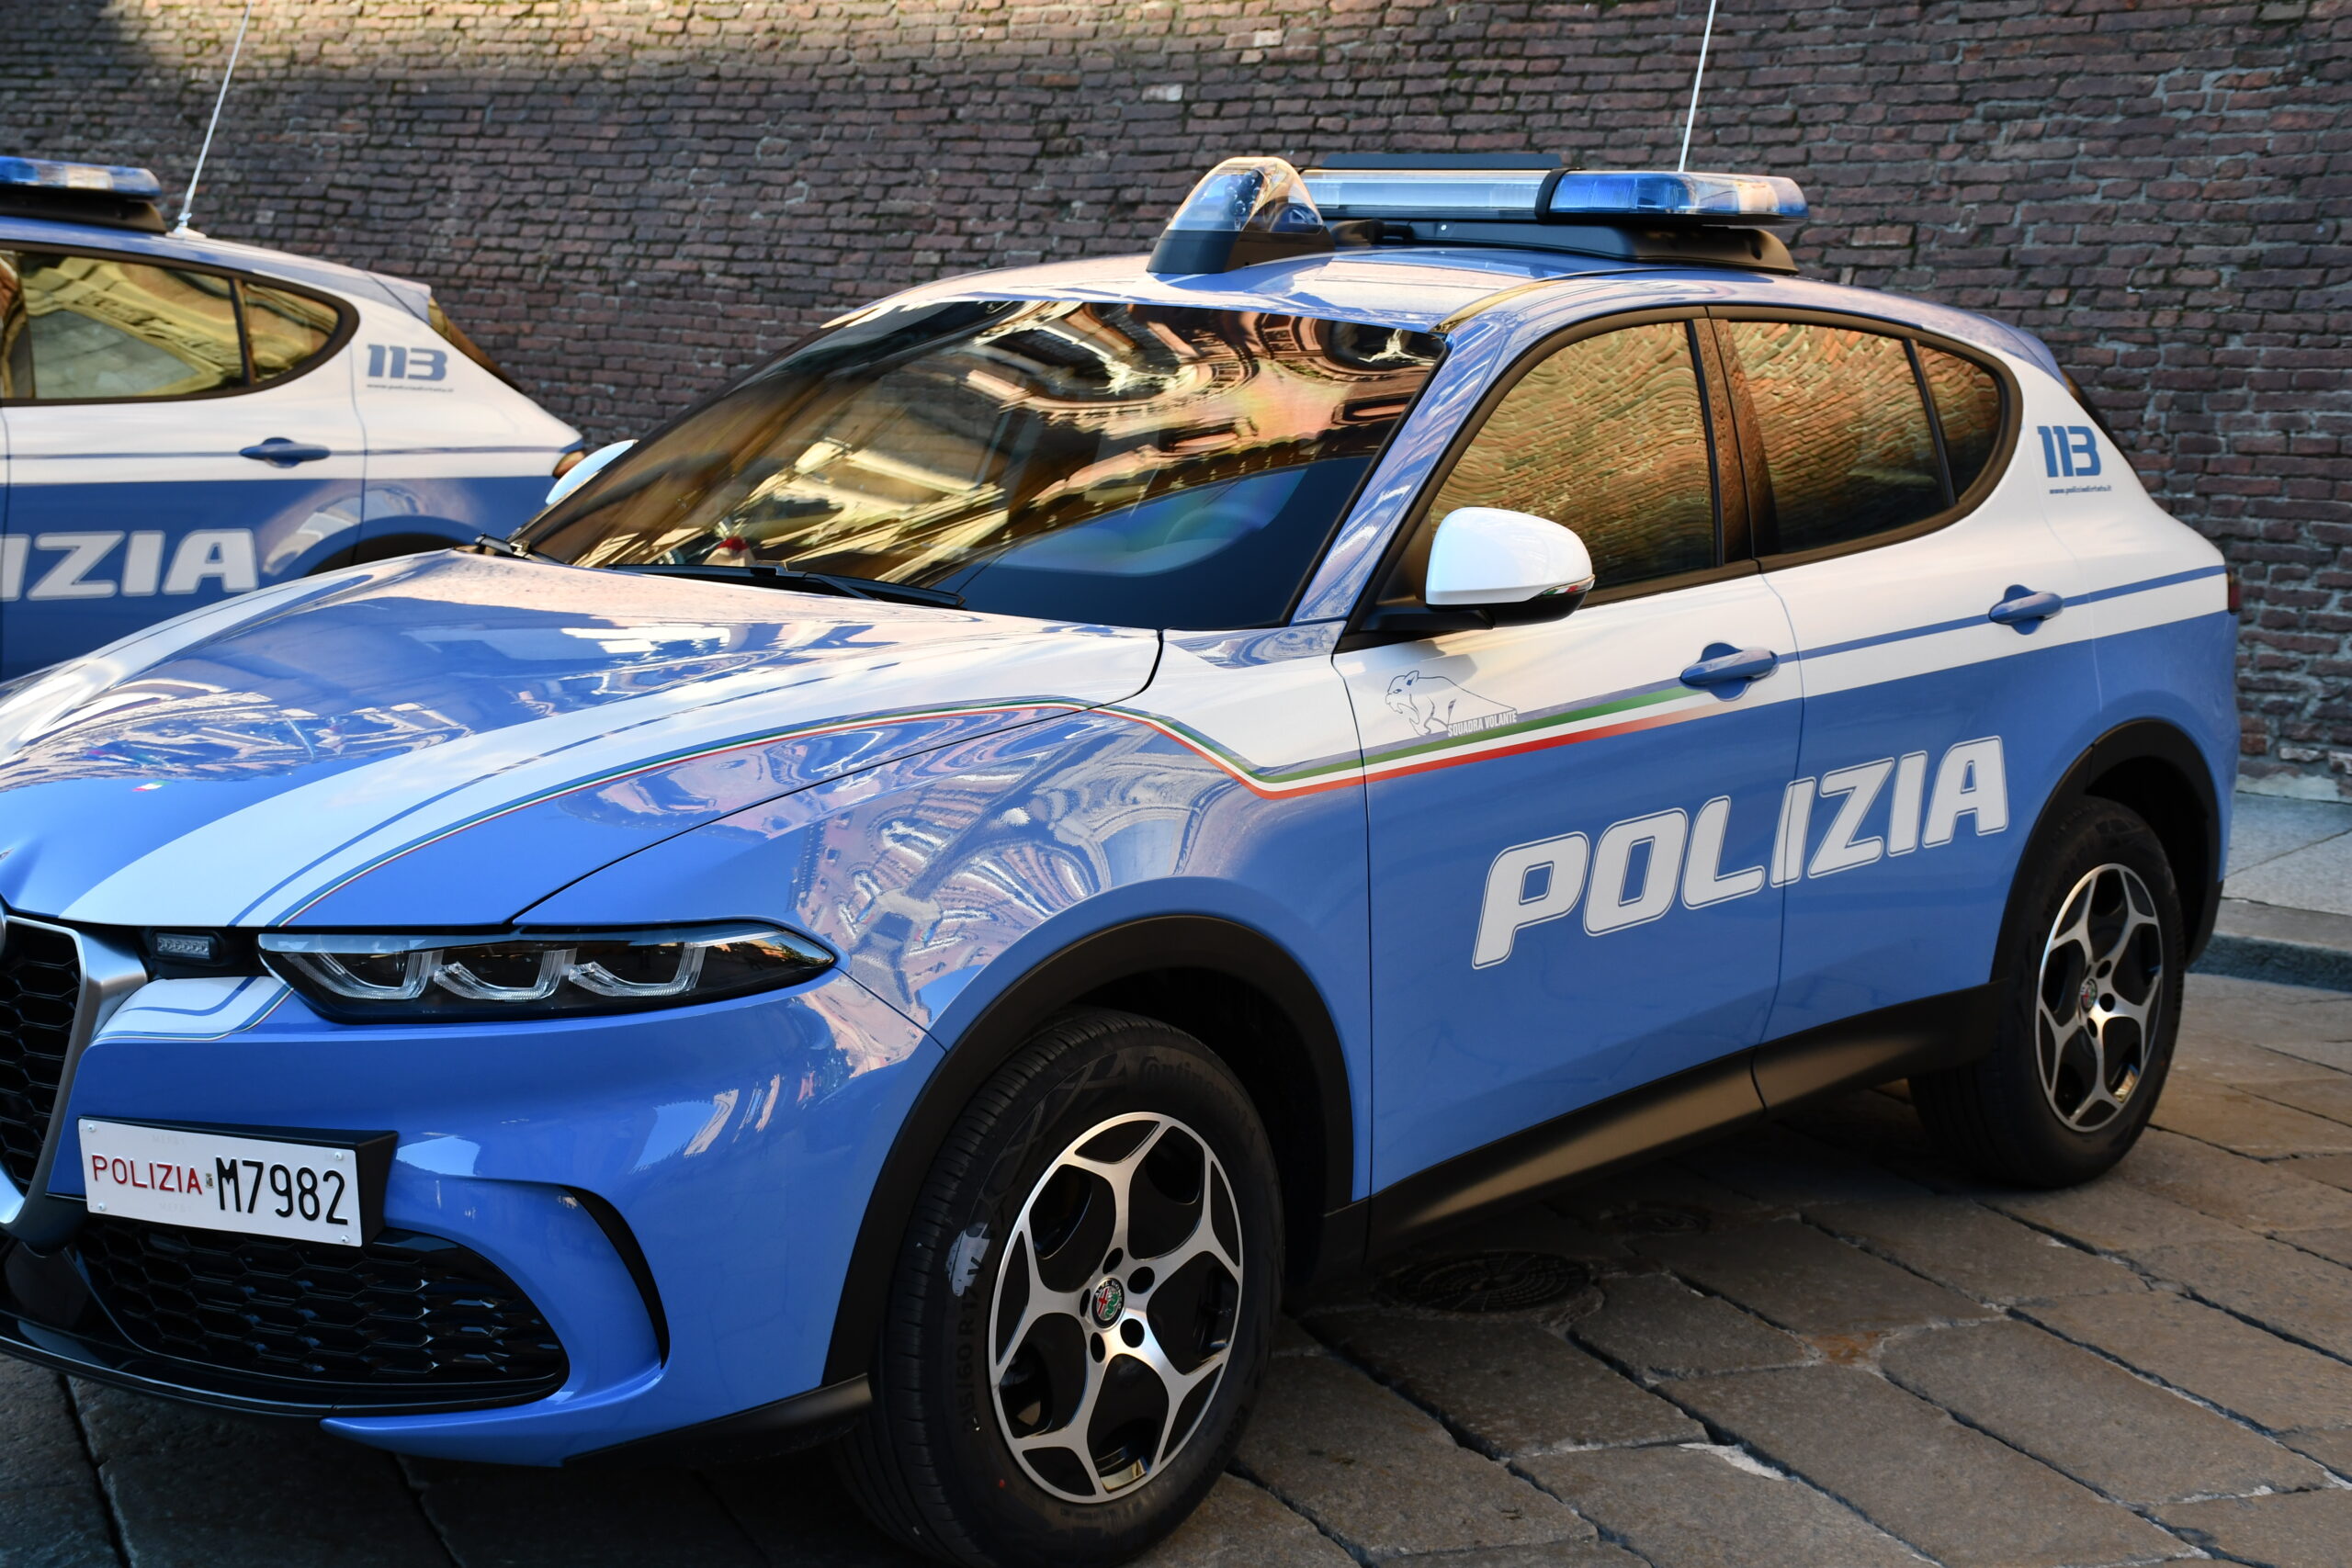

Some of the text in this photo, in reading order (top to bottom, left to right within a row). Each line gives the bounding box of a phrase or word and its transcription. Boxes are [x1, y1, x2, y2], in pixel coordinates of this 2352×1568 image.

[368, 344, 447, 381] 113
[2036, 425, 2101, 478] 113
[1447, 711, 1517, 737] SQUADRA VOLANTE
[1472, 735, 2009, 969] POLIZIA
[92, 1154, 349, 1225] POLIZIA M7982
